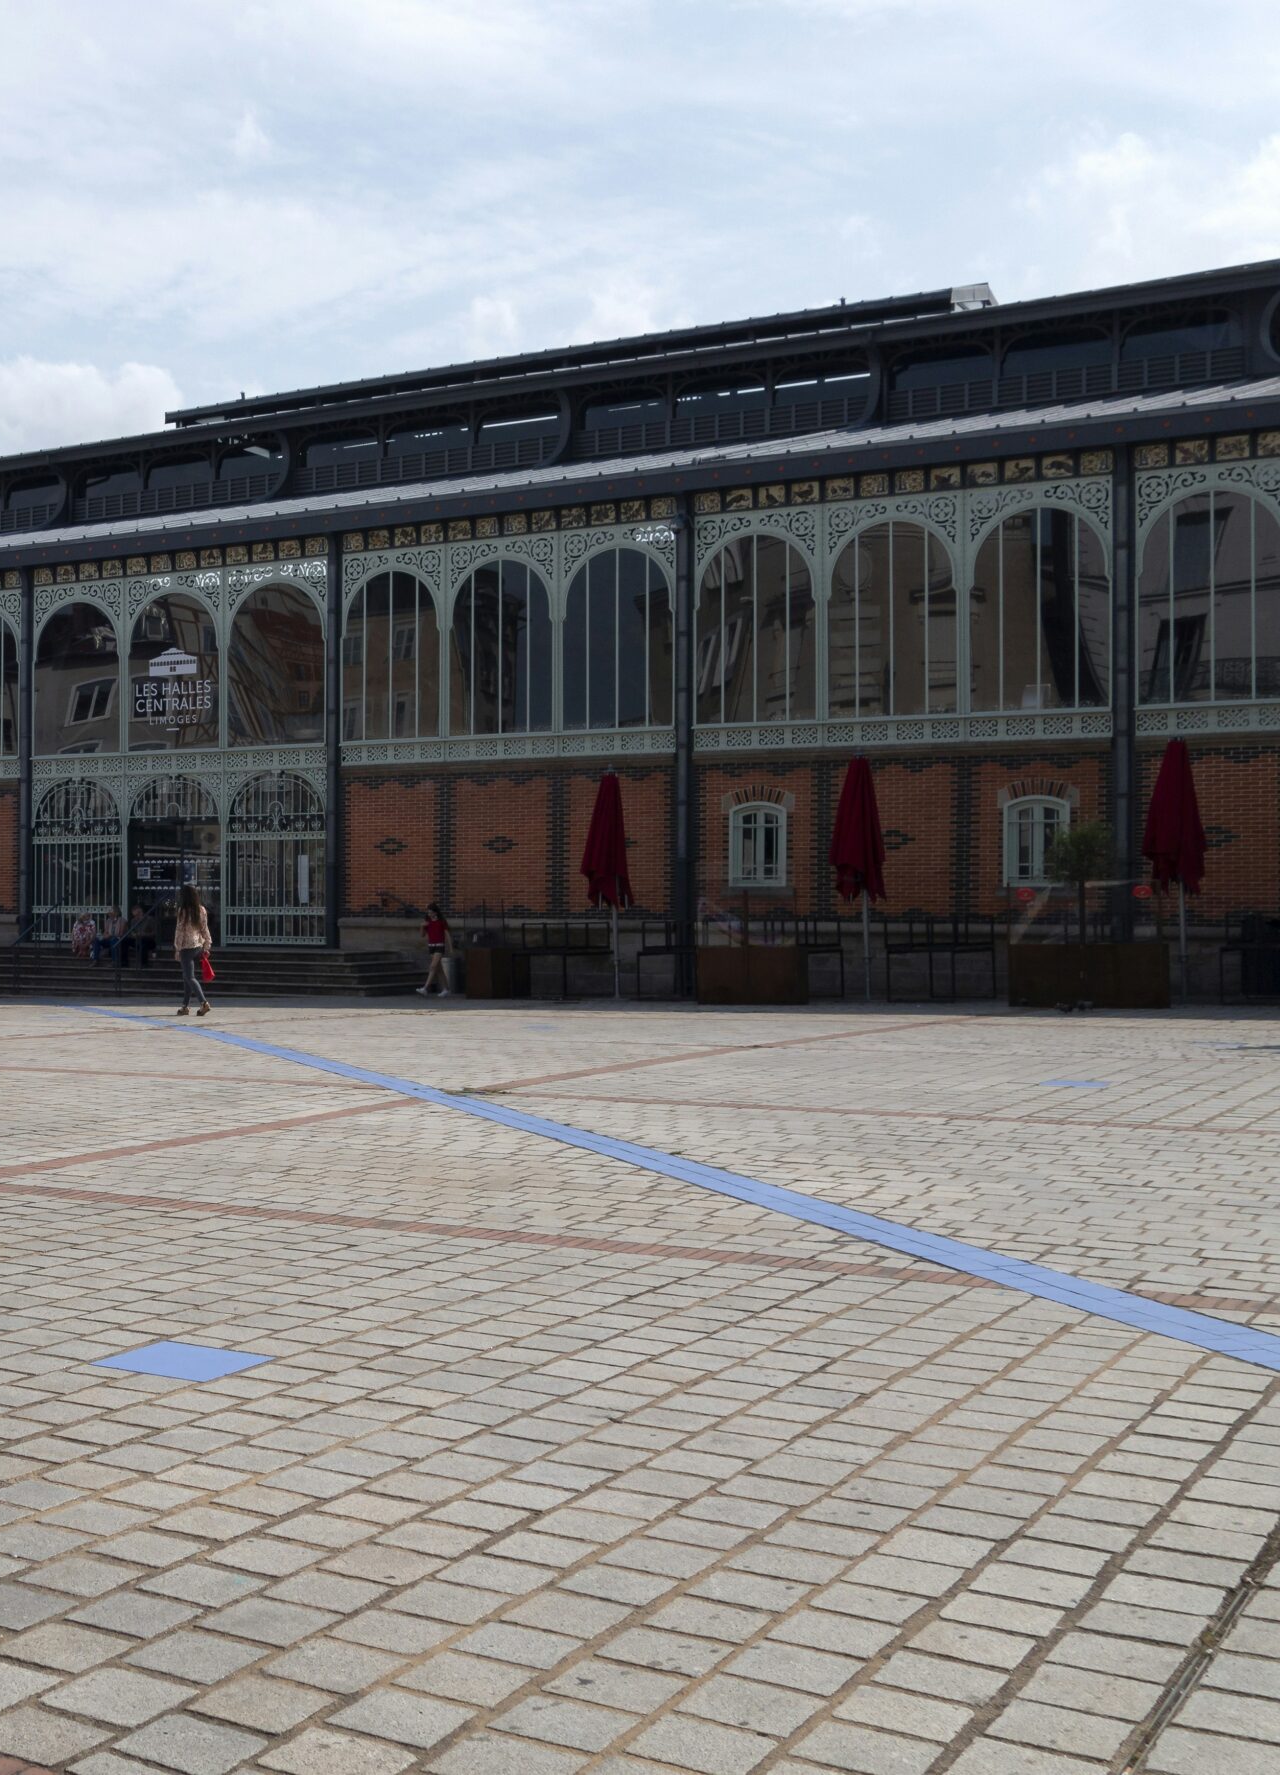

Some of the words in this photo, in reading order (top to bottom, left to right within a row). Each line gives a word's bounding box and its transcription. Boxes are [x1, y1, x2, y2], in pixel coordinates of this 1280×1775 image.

[135, 683, 157, 697] LES
[162, 680, 211, 695] HALLES
[136, 696, 211, 712] CENTRALES
[149, 714, 197, 725] LIMOGES
